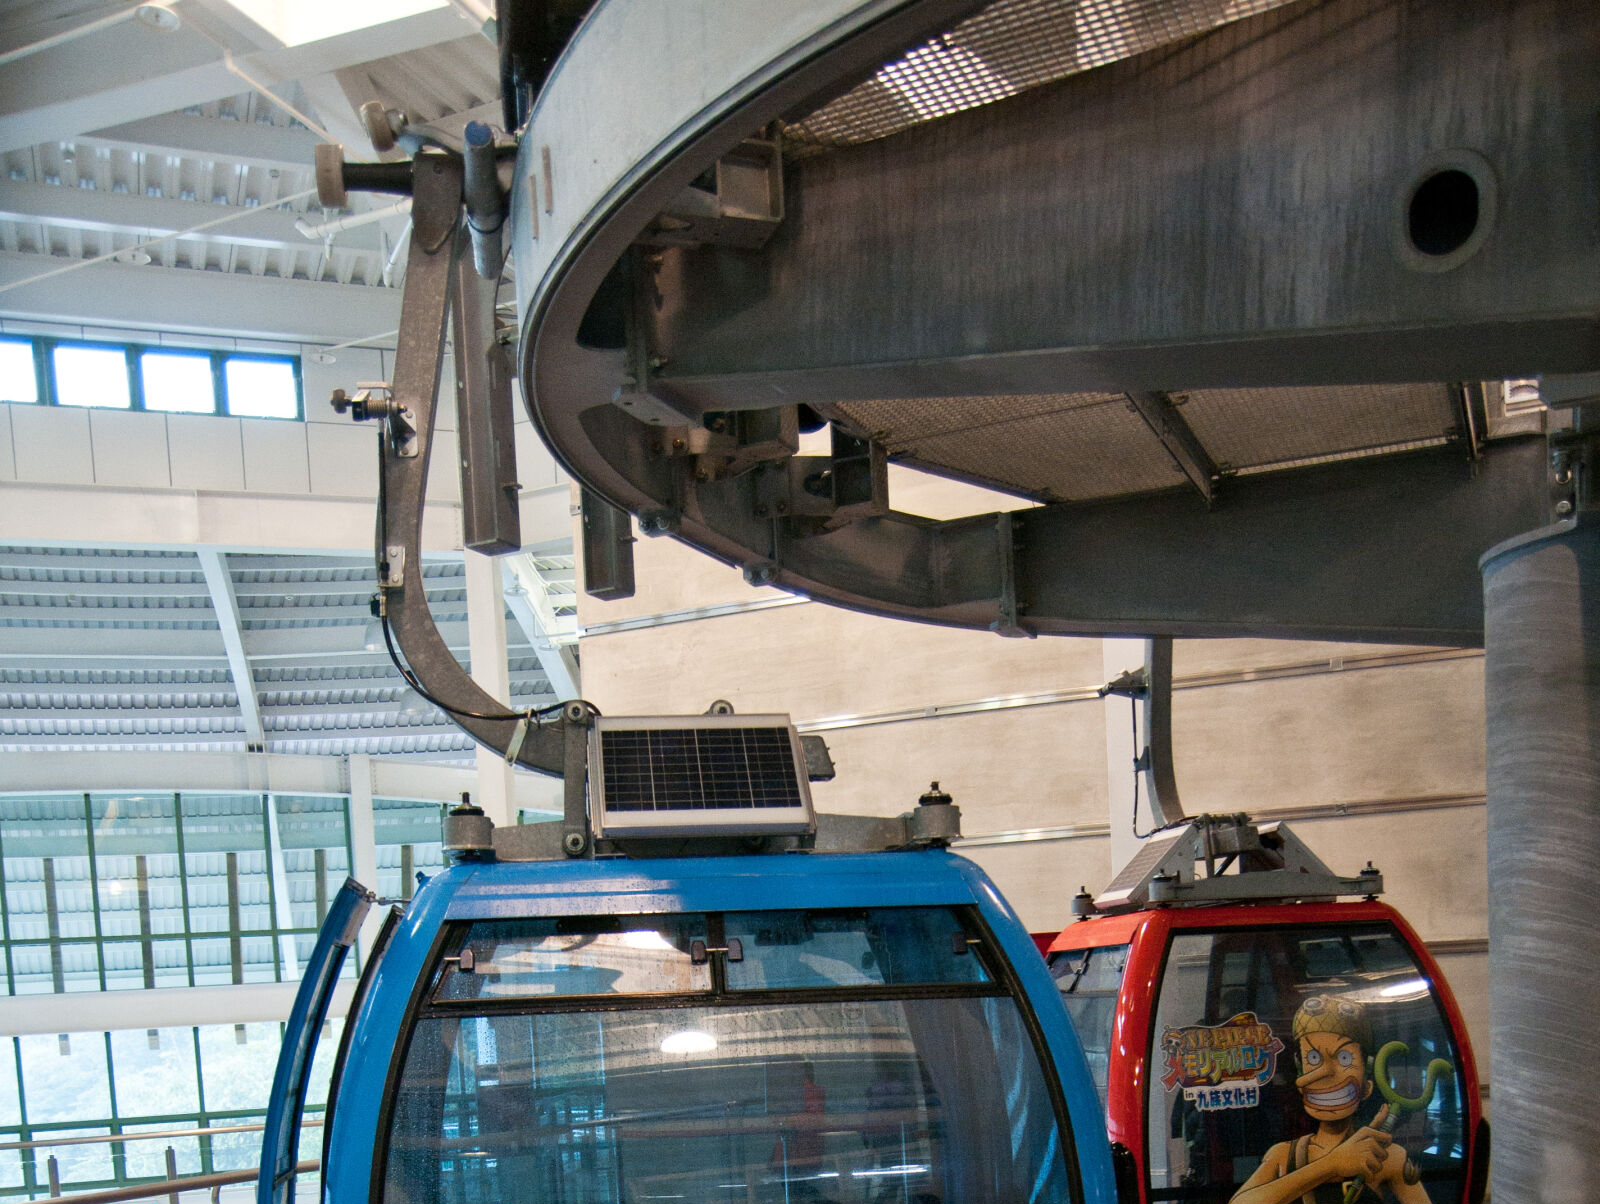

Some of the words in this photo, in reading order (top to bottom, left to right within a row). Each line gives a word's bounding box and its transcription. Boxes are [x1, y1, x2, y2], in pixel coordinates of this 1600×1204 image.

[1185, 1090, 1194, 1099] in
[1197, 1087, 1257, 1109] 九族文化村
